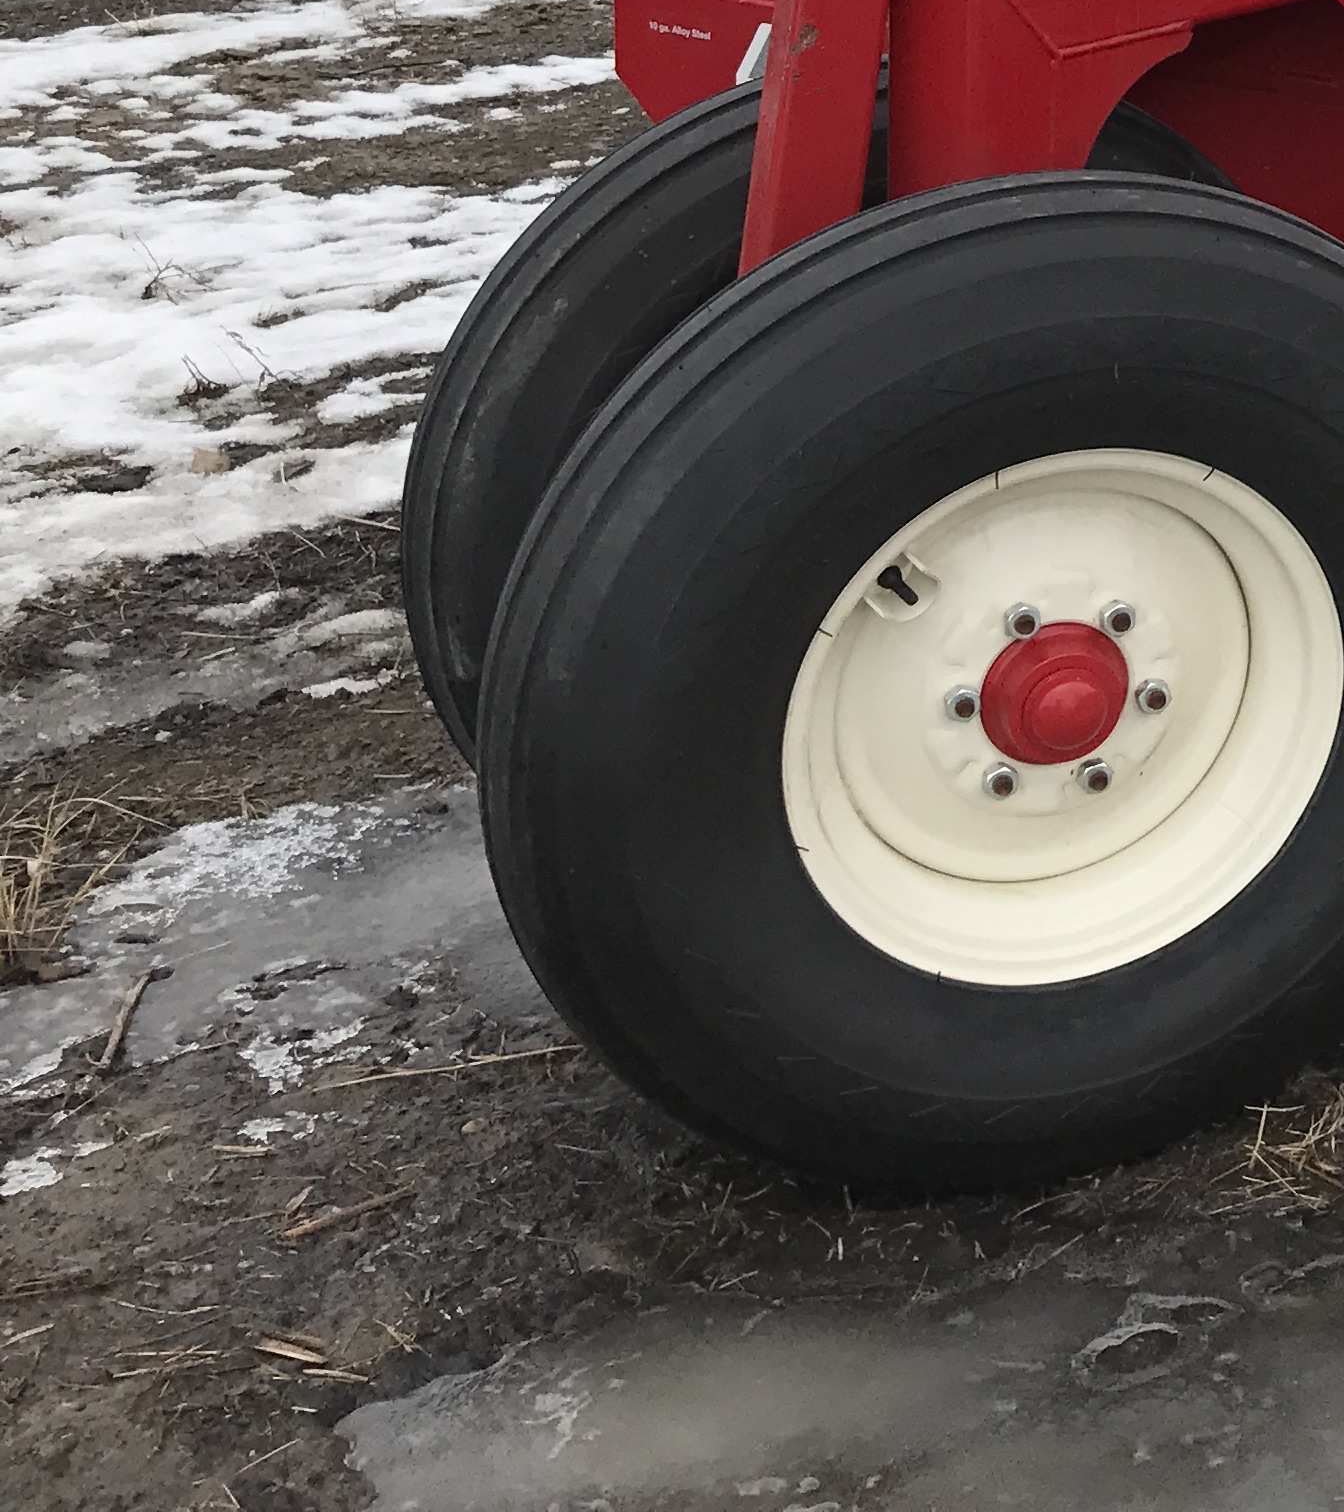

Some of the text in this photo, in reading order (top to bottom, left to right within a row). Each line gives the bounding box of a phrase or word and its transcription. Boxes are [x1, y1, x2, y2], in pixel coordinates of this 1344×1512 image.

[649, 21, 711, 40] 10 ga. Alloy Steel
